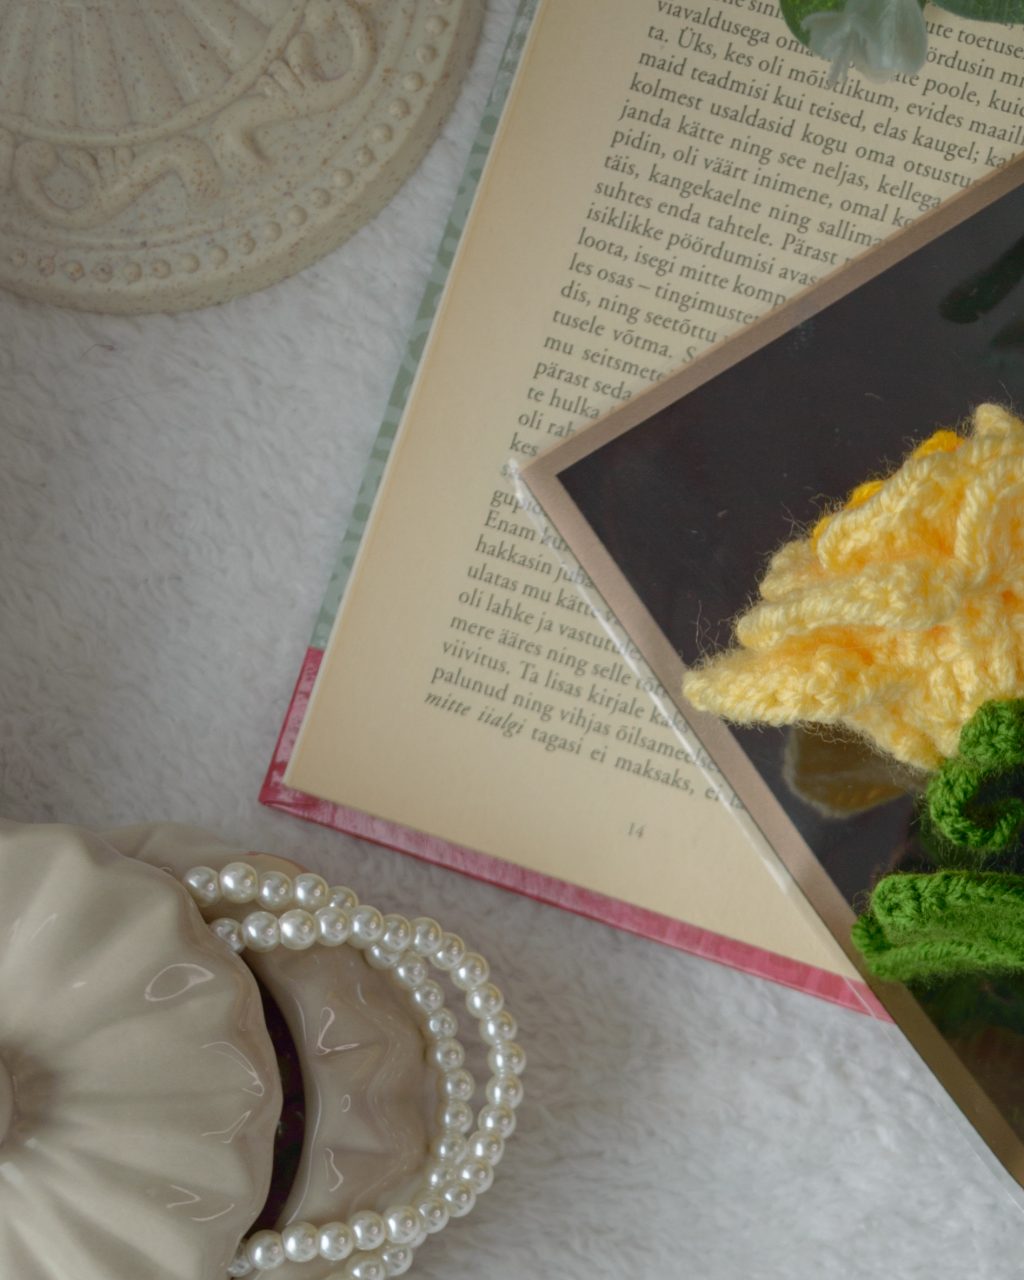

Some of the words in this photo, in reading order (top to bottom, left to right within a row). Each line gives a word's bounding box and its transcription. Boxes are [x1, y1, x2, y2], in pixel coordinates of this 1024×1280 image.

[629, 71, 704, 111] kolmest
[709, 102, 796, 138] usaldasid
[800, 122, 848, 156] kogu
[854, 146, 896, 168] oma
[637, 52, 688, 77] maid
[690, 67, 771, 102] teadmisi
[772, 85, 806, 112] kui
[808, 101, 867, 132] teised,
[872, 116, 908, 142] elas
[911, 125, 980, 165] kaugel;
[921, 78, 981, 107] poole,
[609, 128, 666, 159] pidin,
[672, 145, 700, 166] oli
[703, 156, 749, 182] väärt
[752, 167, 833, 209] inimene,
[839, 199, 889, 223] omal
[594, 180, 653, 209] suhtes
[657, 201, 702, 225] enda
[707, 214, 773, 247] tahtele.
[780, 232, 838, 266] Pärast
[577, 226, 628, 262] loota,
[633, 245, 677, 278] isegi
[678, 264, 729, 290] mitte
[552, 310, 606, 337] tusele
[613, 329, 673, 359] võtma.
[560, 279, 591, 307] dis,
[597, 294, 641, 325] ning
[643, 311, 717, 344] seetõttu
[532, 361, 591, 389] pärast
[592, 380, 632, 401] seda
[508, 431, 539, 457] kes
[467, 562, 518, 592] ulatas
[521, 583, 552, 604] mu
[474, 533, 553, 576] hakkasin
[442, 639, 510, 675] viivitus.
[519, 660, 539, 684] Ta
[544, 669, 582, 698] lisas
[586, 683, 645, 719] kirjale
[449, 616, 496, 640] mere
[497, 628, 542, 656] ääres
[546, 646, 589, 677] ning
[591, 661, 632, 686] selle
[423, 692, 472, 716] mitte
[476, 705, 527, 738] iialgi
[531, 727, 584, 755] tagasi
[589, 745, 608, 764] ei
[614, 756, 695, 795] maksaks,
[627, 821, 646, 839] 14
